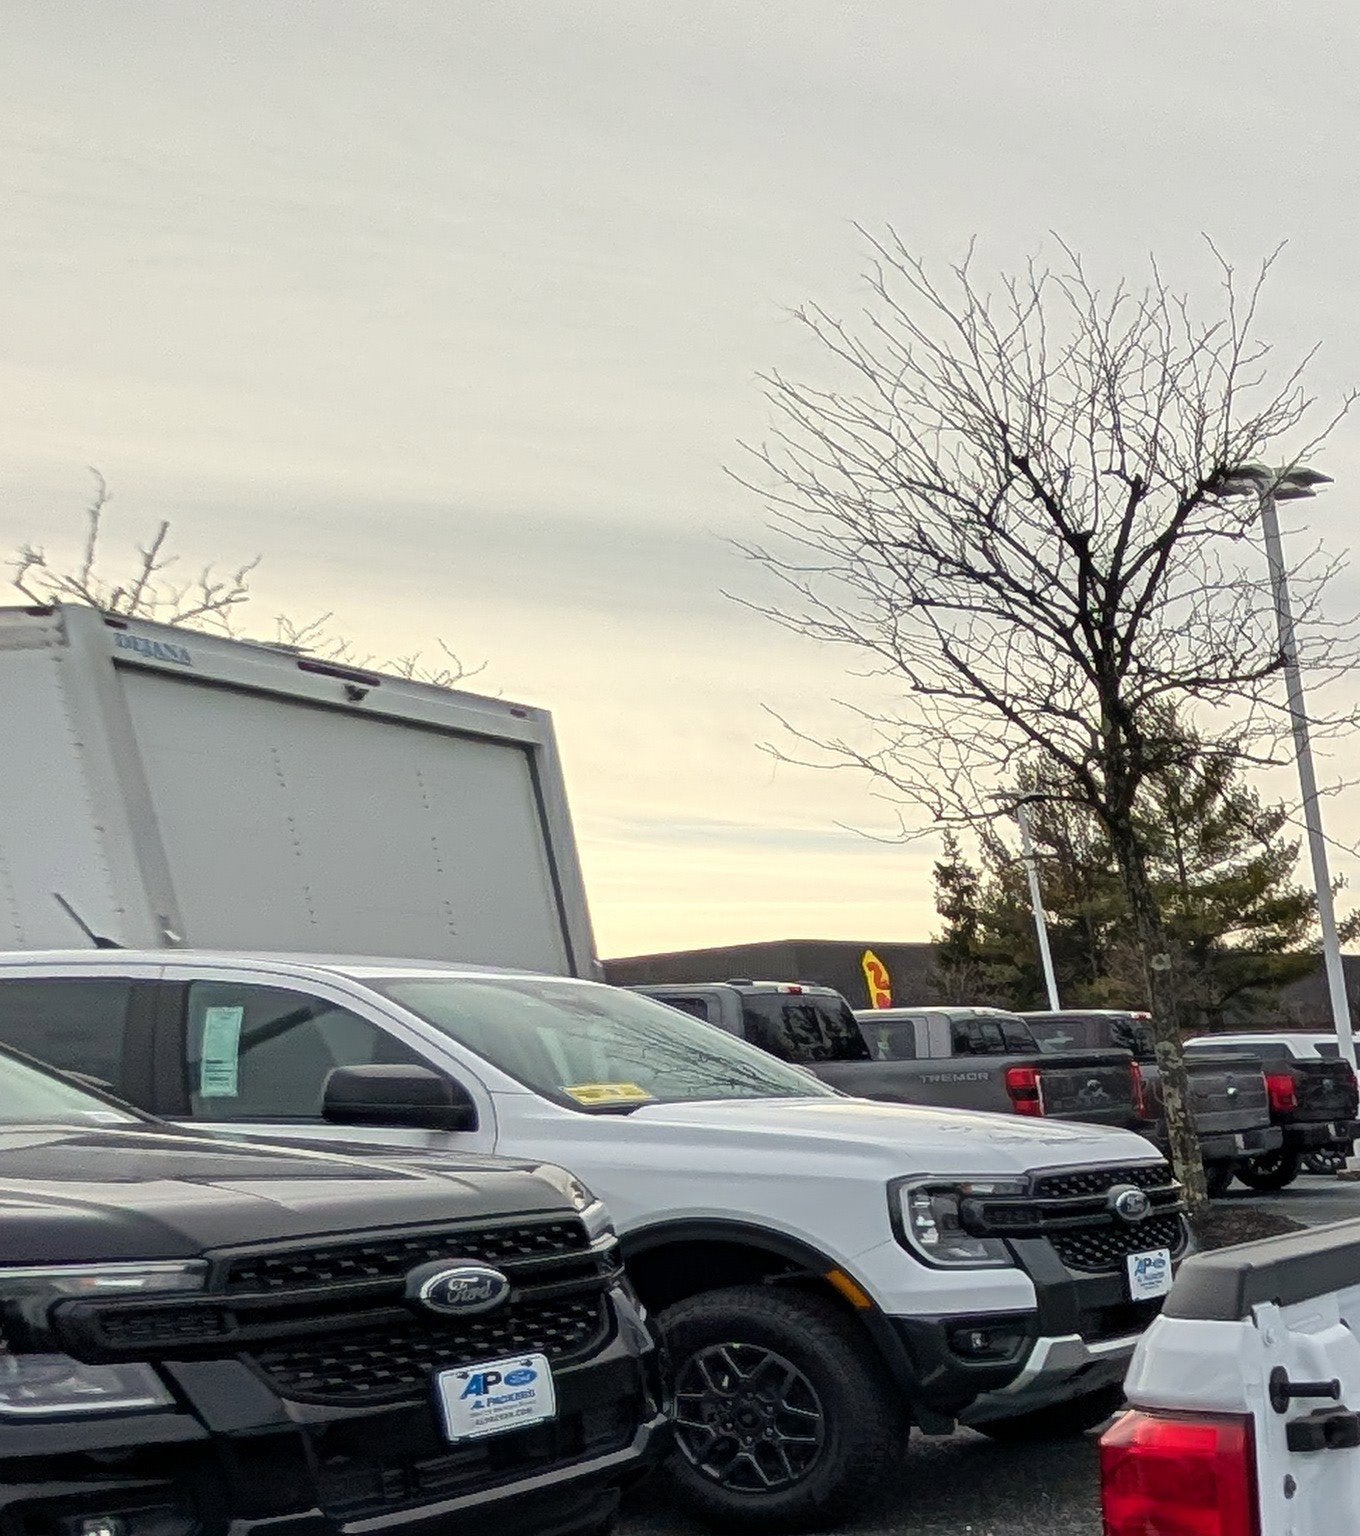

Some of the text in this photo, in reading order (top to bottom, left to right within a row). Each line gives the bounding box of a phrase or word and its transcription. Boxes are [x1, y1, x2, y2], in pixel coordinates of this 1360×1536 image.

[919, 1072, 989, 1084] TREMOR
[446, 1276, 493, 1304] Ford
[460, 1371, 502, 1400] AP
